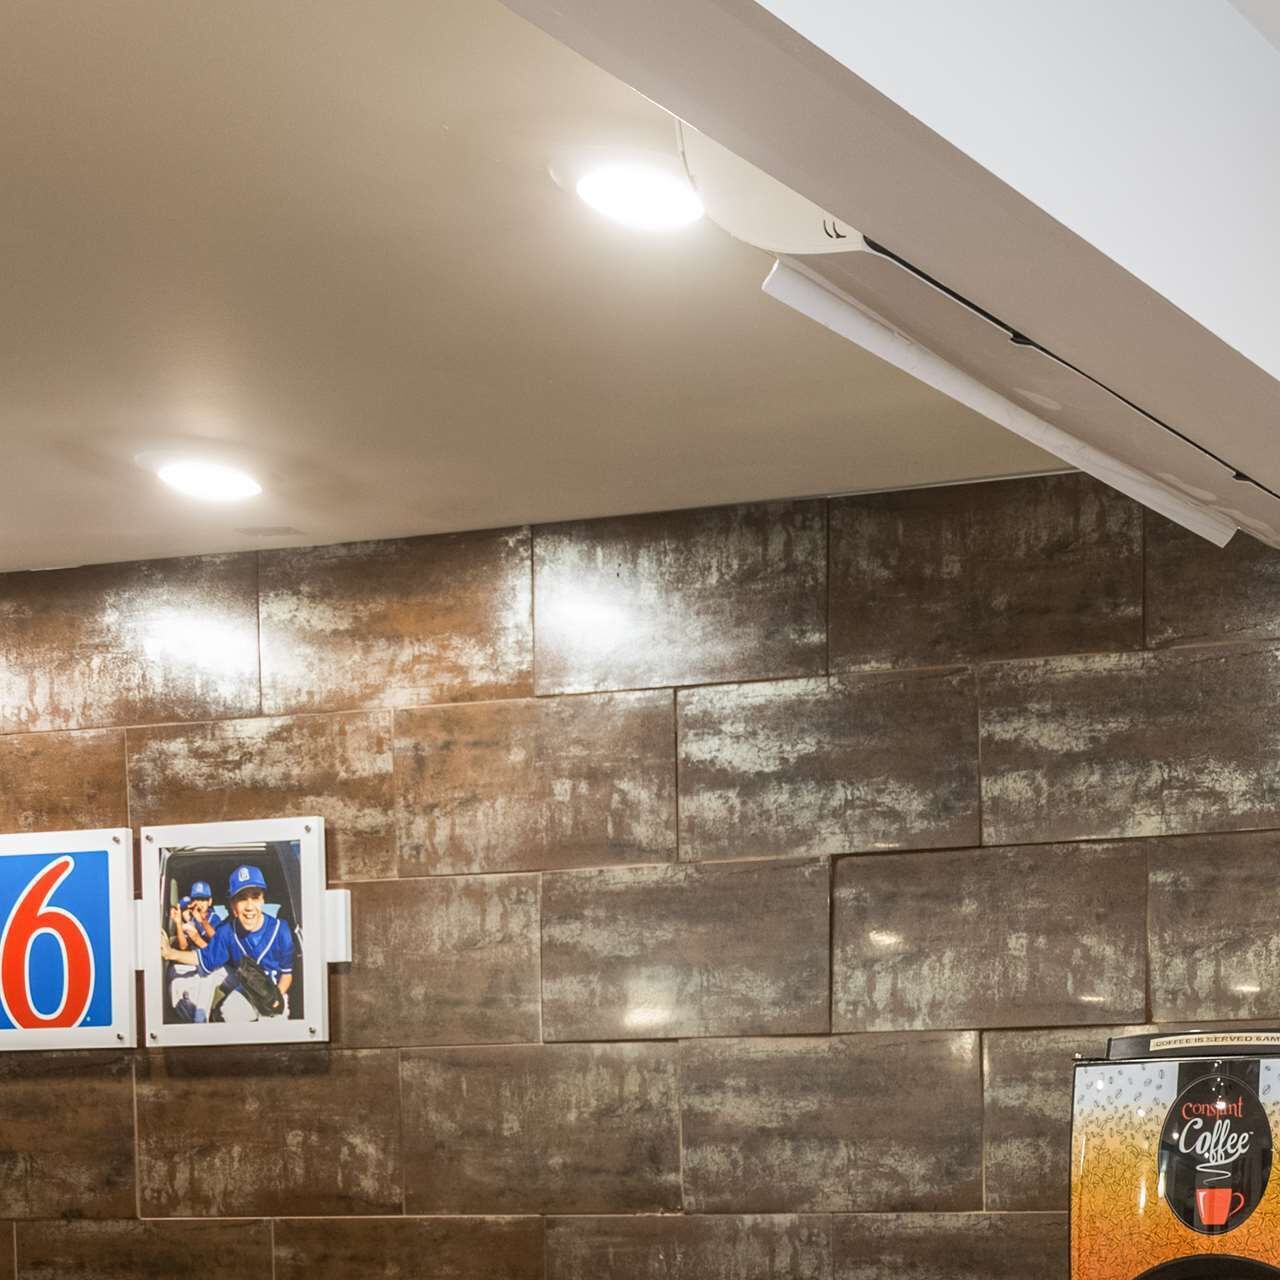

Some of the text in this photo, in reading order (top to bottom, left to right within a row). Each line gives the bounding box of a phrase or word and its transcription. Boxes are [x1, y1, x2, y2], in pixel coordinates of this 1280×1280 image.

[0, 854, 95, 1030] 6
[1155, 1037, 1191, 1047] COFFEE
[1206, 1035, 1251, 1043] SERVED
[1255, 1035, 1276, 1043] 6AM
[1178, 1117, 1250, 1165] Coffee
